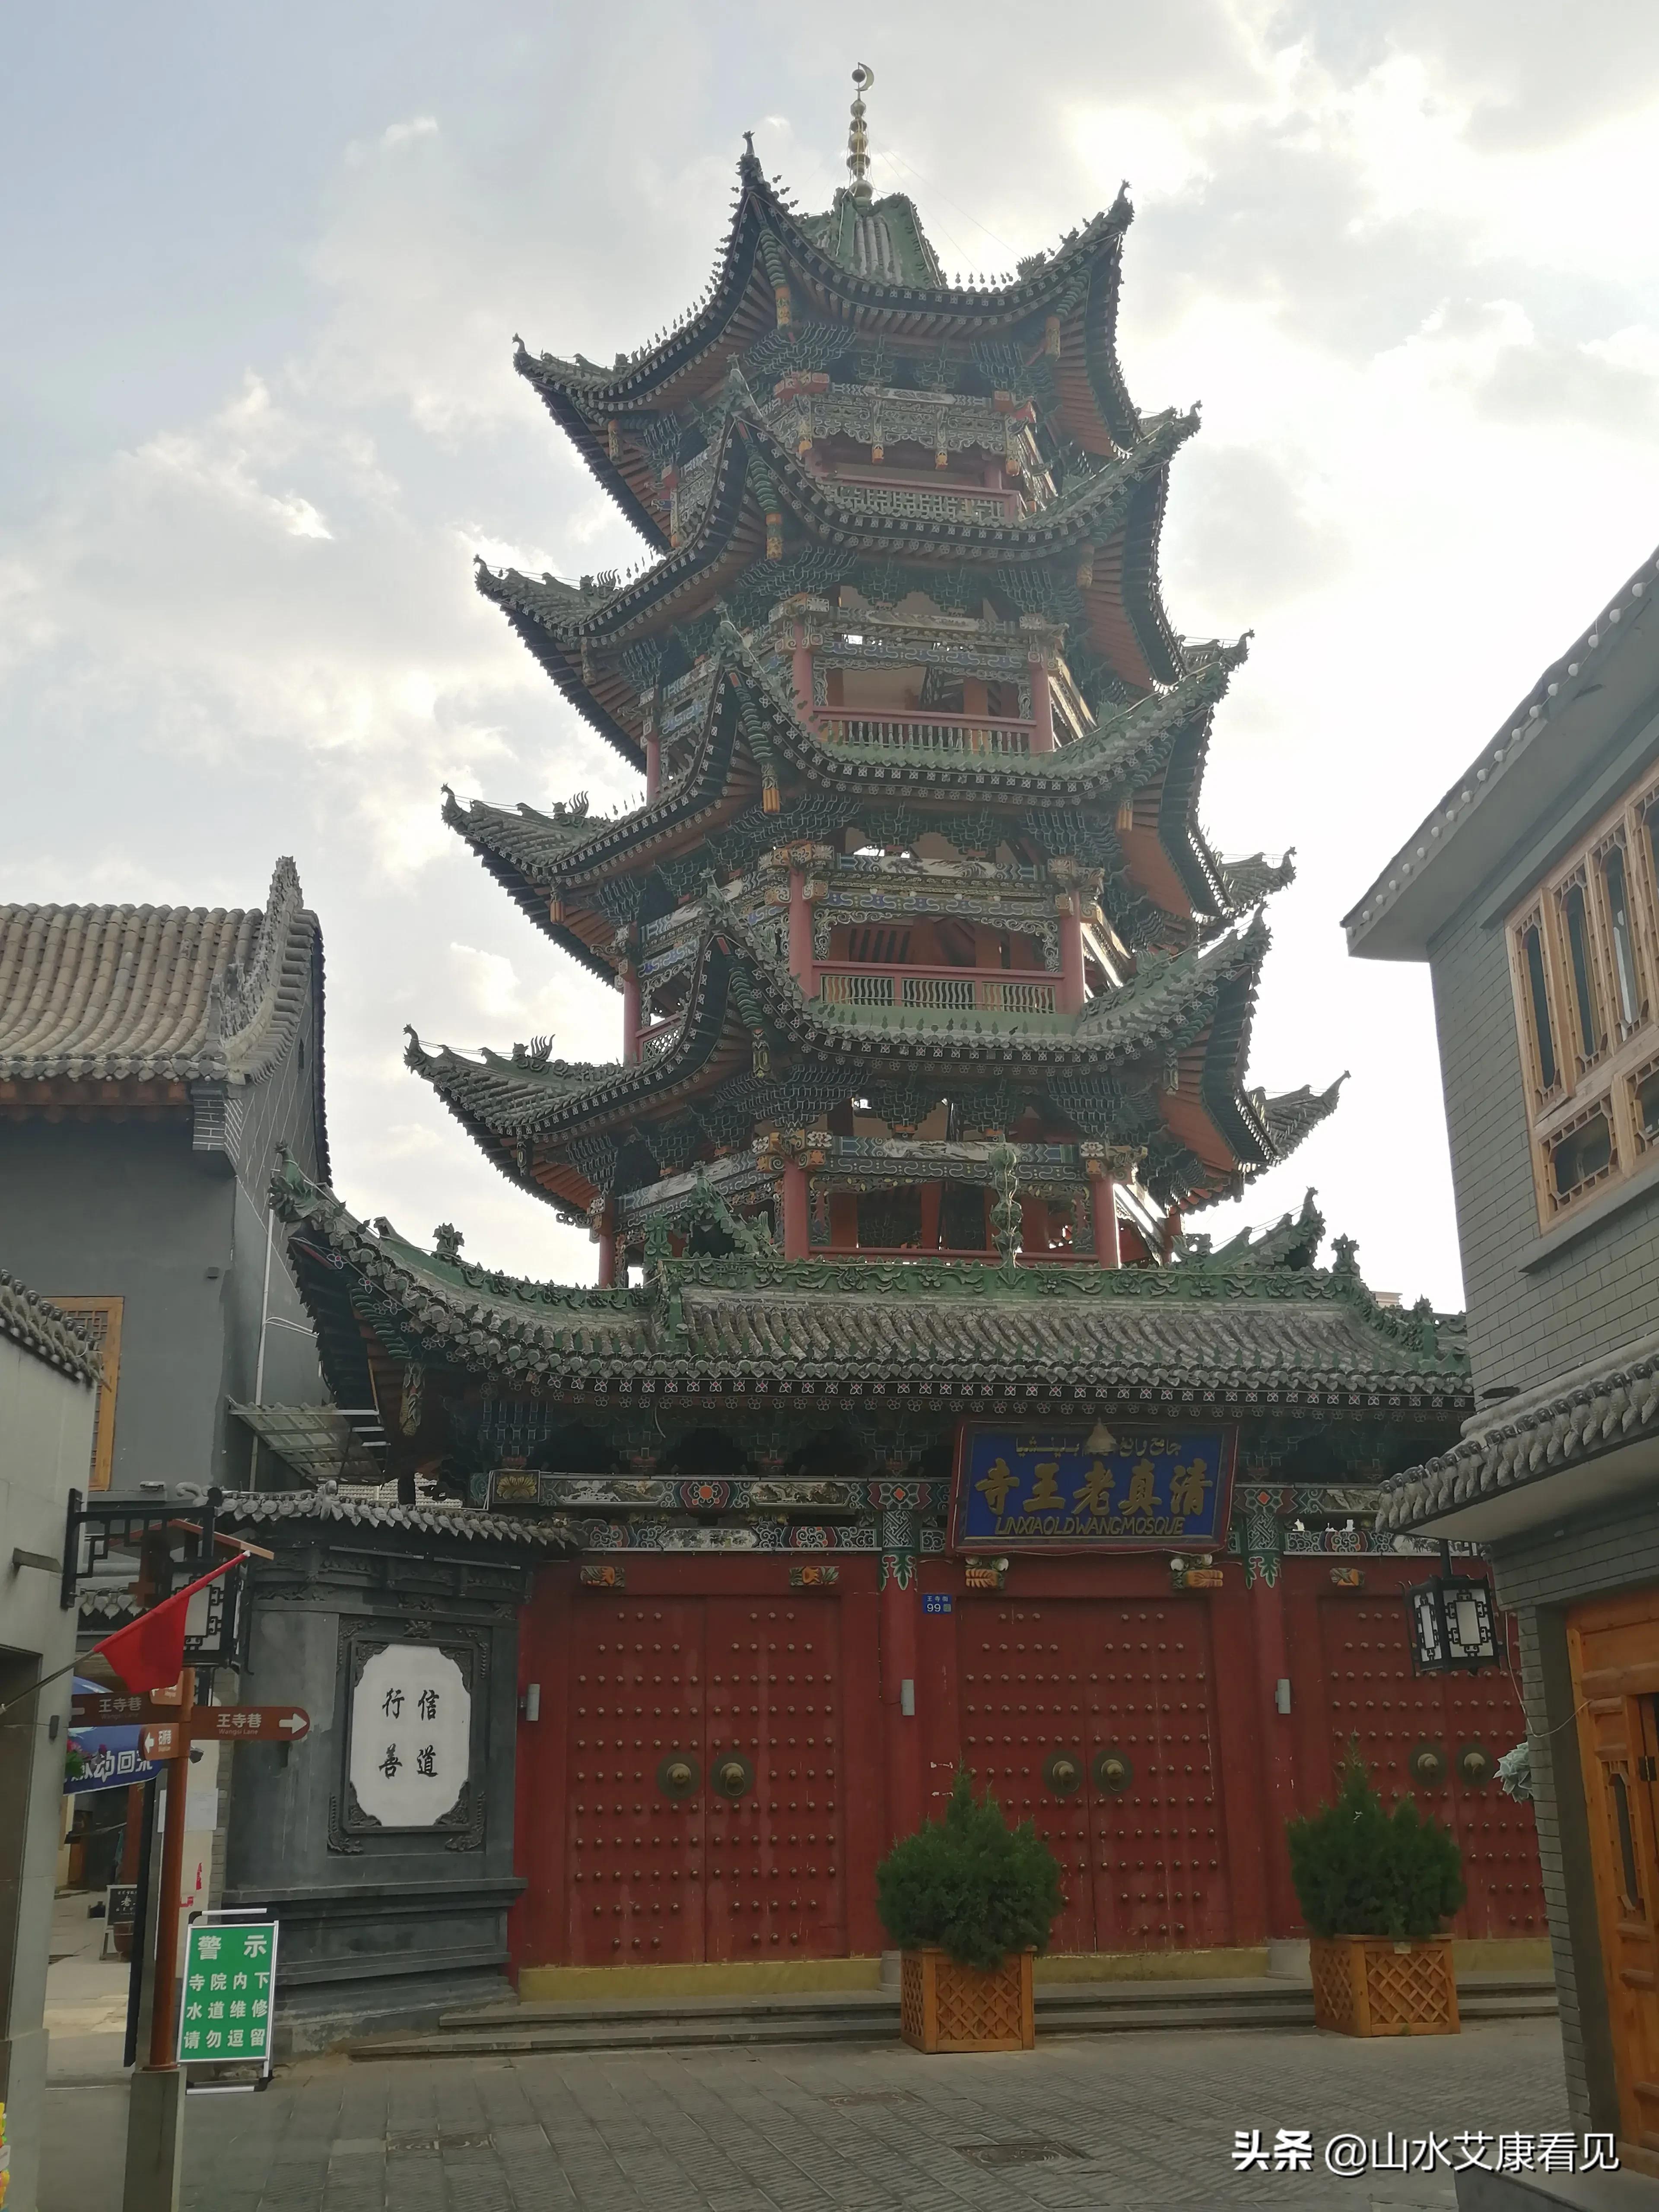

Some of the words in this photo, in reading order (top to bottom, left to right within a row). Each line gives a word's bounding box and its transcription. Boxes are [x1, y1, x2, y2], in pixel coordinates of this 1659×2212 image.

[975, 1457, 1213, 1516] 清真老王寺
[927, 1603, 941, 1612] 99
[99, 1697, 142, 1713] 王寺巷
[216, 1713, 262, 1728] 王寺巷
[198, 1935, 267, 1960] 警示
[189, 1972, 270, 1992] 寺院内下
[186, 1999, 268, 2020] 水道维修
[184, 2028, 265, 2049] 请勿逗留
